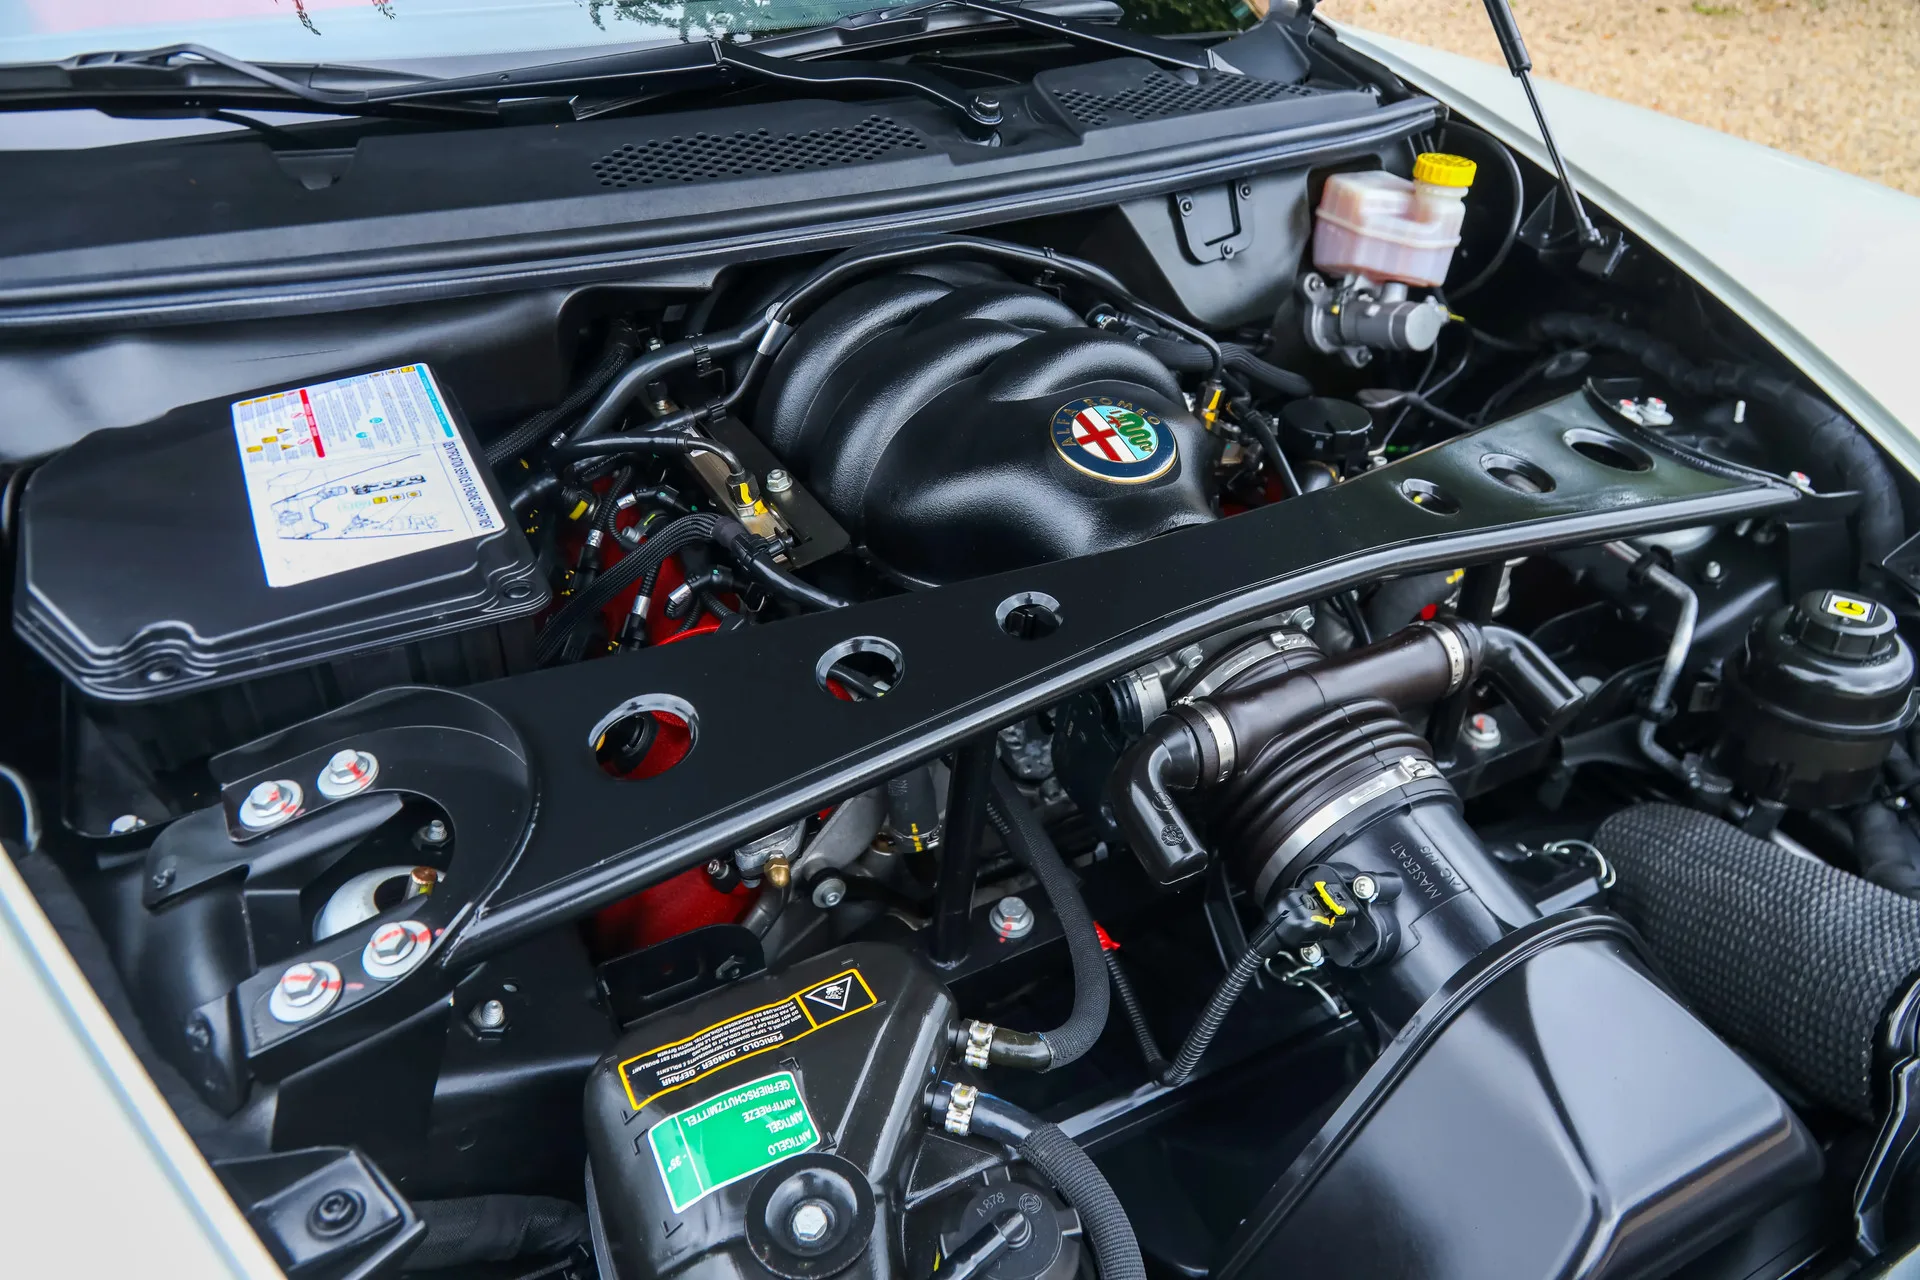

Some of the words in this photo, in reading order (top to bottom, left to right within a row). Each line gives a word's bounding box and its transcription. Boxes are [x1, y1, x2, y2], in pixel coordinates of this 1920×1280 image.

[1057, 408, 1078, 447] ALFA
[1083, 397, 1161, 426] ROMEO
[1389, 841, 1442, 899] MASERATI
[1440, 867, 1461, 887] AC
[766, 1017, 781, 1025] OPEN
[717, 1031, 741, 1043] COOLANT
[741, 1033, 784, 1051] PERICOLO
[750, 1028, 767, 1036] TAPPO
[700, 1049, 737, 1069] DANGER
[660, 1068, 697, 1086] GEFAHR
[683, 1079, 790, 1127] GEFRIERSCHUTZMITTEL
[741, 1097, 796, 1123] ANTIFREEZE
[765, 1110, 804, 1134] ANTIGEL
[768, 1129, 812, 1156] ANTIGELO
